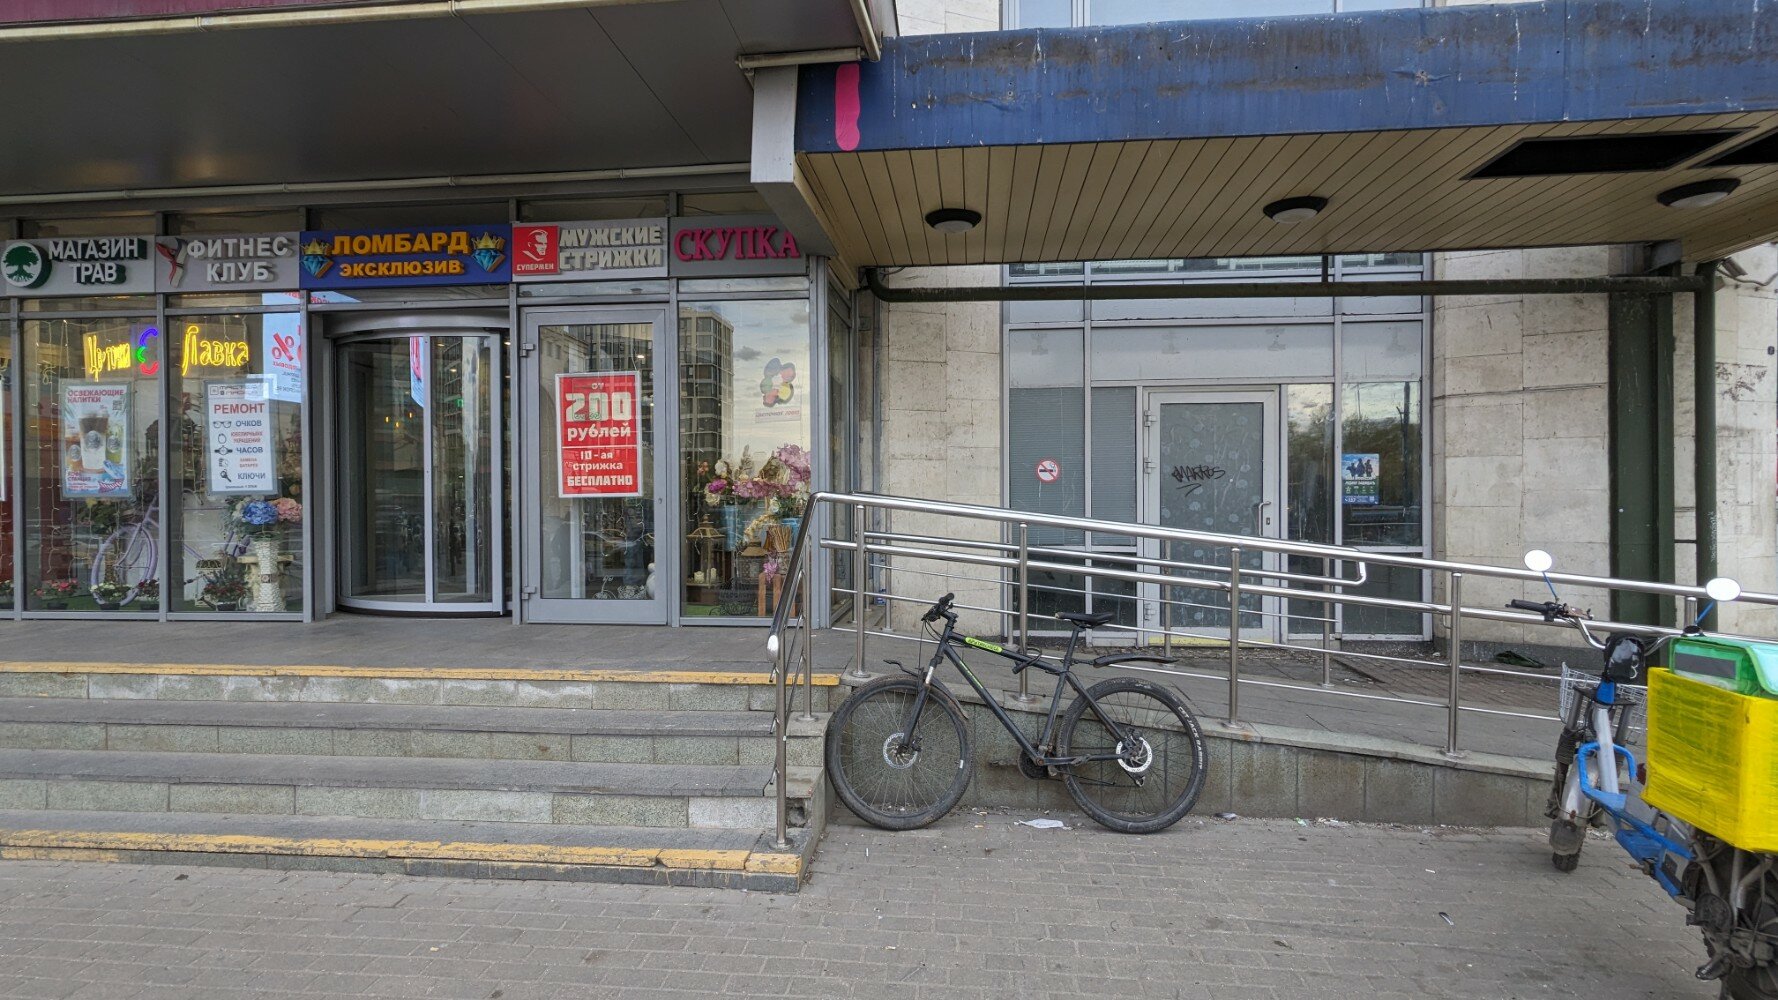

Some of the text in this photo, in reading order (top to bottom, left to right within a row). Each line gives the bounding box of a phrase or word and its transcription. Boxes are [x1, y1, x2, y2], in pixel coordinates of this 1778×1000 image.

[331, 231, 470, 255] ЛОМБАРД
[560, 226, 662, 247] МУЖСКИЕ
[675, 226, 800, 262] СКУПКА
[48, 237, 141, 260] МАГАЗИН
[187, 236, 289, 259] ФИТНЕС
[339, 259, 463, 277] ЭКСКЛЮЗИВ
[516, 263, 554, 271] СУПЕРМЕН
[559, 249, 661, 270] СТРИЖКИ
[69, 262, 119, 283] ТРАВ
[206, 261, 270, 282] КЛУБ
[182, 326, 249, 377] Лавка
[67, 388, 124, 397] ОСВЕЖАЮЩИЕ
[67, 396, 101, 404] НАПИТКИ
[214, 403, 265, 414] РЕМОНТ
[565, 391, 631, 422] 200
[567, 422, 631, 441] рублей
[237, 472, 266, 480] КЛЮЧИ
[572, 462, 623, 472] стрижка
[567, 475, 633, 487] БЕСПЛАТНО
[1187, 719, 1200, 738] JACK
